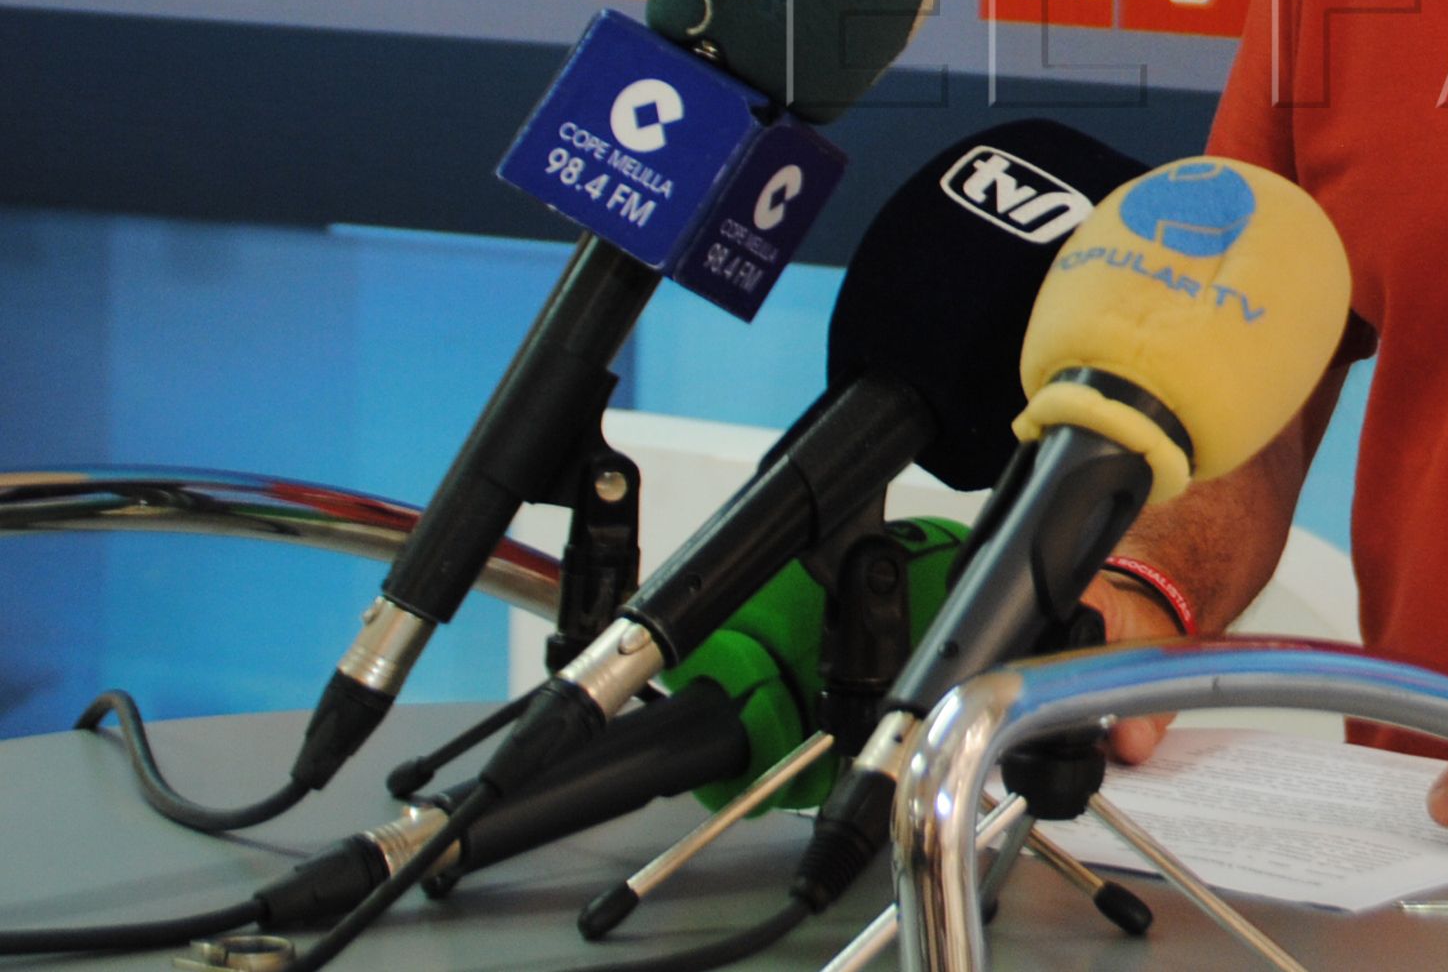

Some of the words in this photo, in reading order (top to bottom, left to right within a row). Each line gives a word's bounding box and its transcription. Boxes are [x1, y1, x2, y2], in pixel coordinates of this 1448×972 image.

[545, 148, 610, 201] 98.4
[606, 186, 657, 228] FM
[558, 122, 611, 160] COPE
[608, 146, 674, 199] MELILLA
[703, 241, 742, 279] 98.4
[731, 259, 763, 292] FM
[1059, 246, 1201, 298] OPULAR
[1212, 283, 1267, 324] TV
